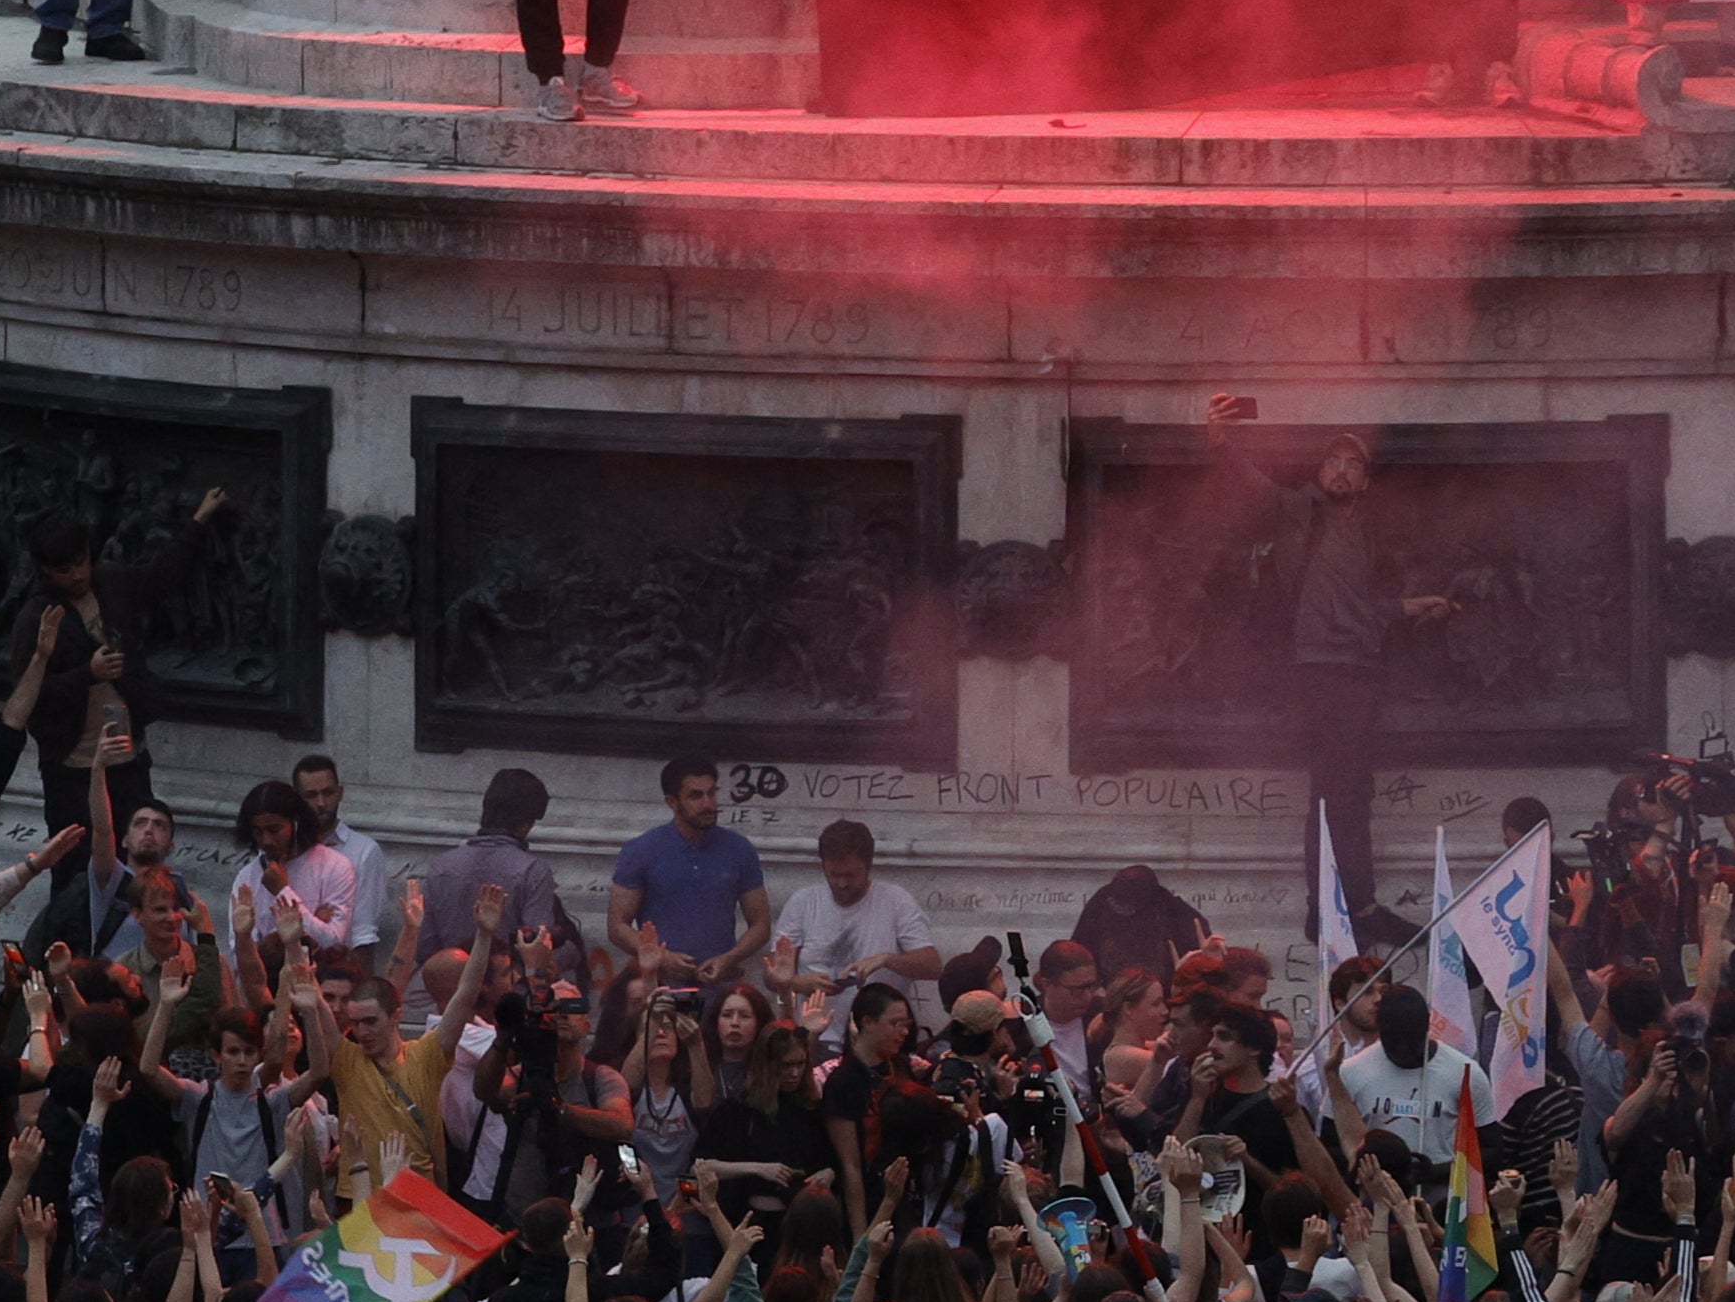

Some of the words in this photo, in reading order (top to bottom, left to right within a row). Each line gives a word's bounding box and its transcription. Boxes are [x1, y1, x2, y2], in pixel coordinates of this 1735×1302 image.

[804, 768, 914, 802] VOTEZ
[936, 771, 1053, 807] FRONT
[1073, 771, 1292, 816] POPULAIRE
[1372, 1097, 1443, 1118] JON
